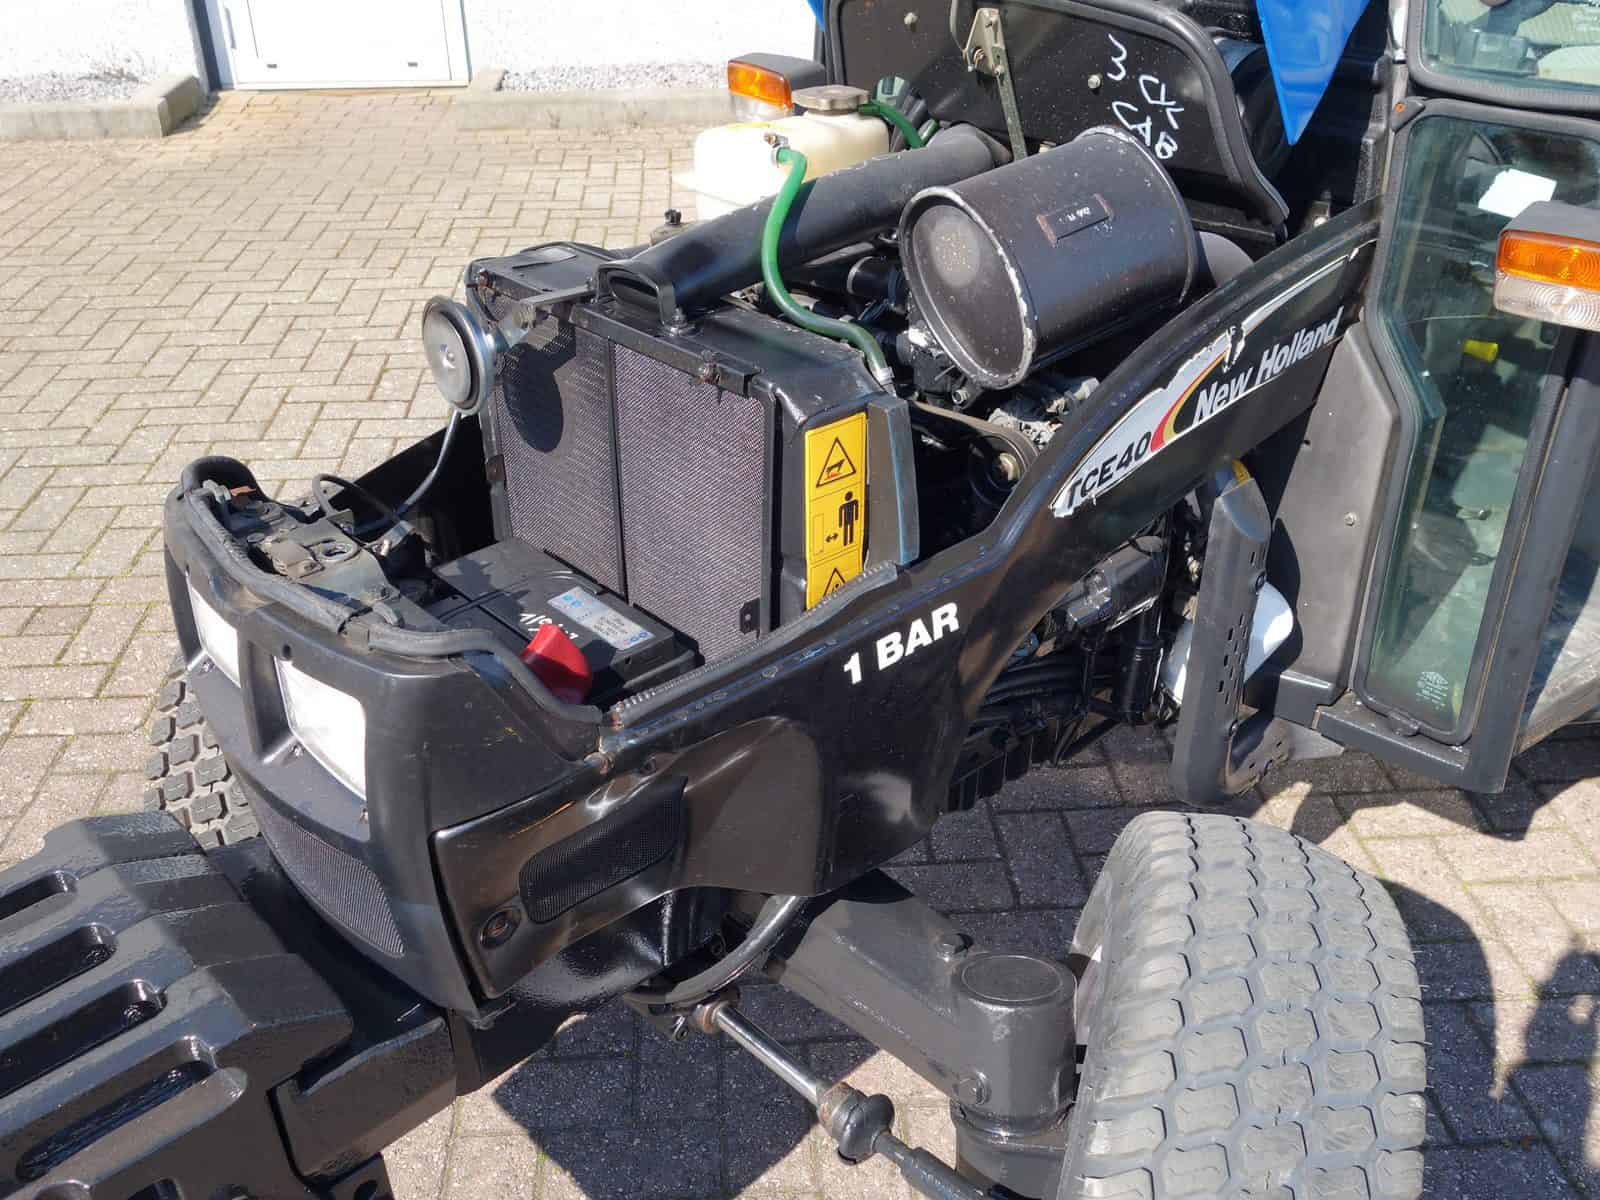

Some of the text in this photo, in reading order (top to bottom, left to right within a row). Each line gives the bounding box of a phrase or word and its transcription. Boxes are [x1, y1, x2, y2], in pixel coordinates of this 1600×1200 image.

[1107, 33, 1128, 81] 3
[1112, 101, 1178, 159] CAB
[1192, 305, 1345, 427] New Holland
[1067, 431, 1152, 510] TCE40
[843, 602, 960, 685] 1 BAR
